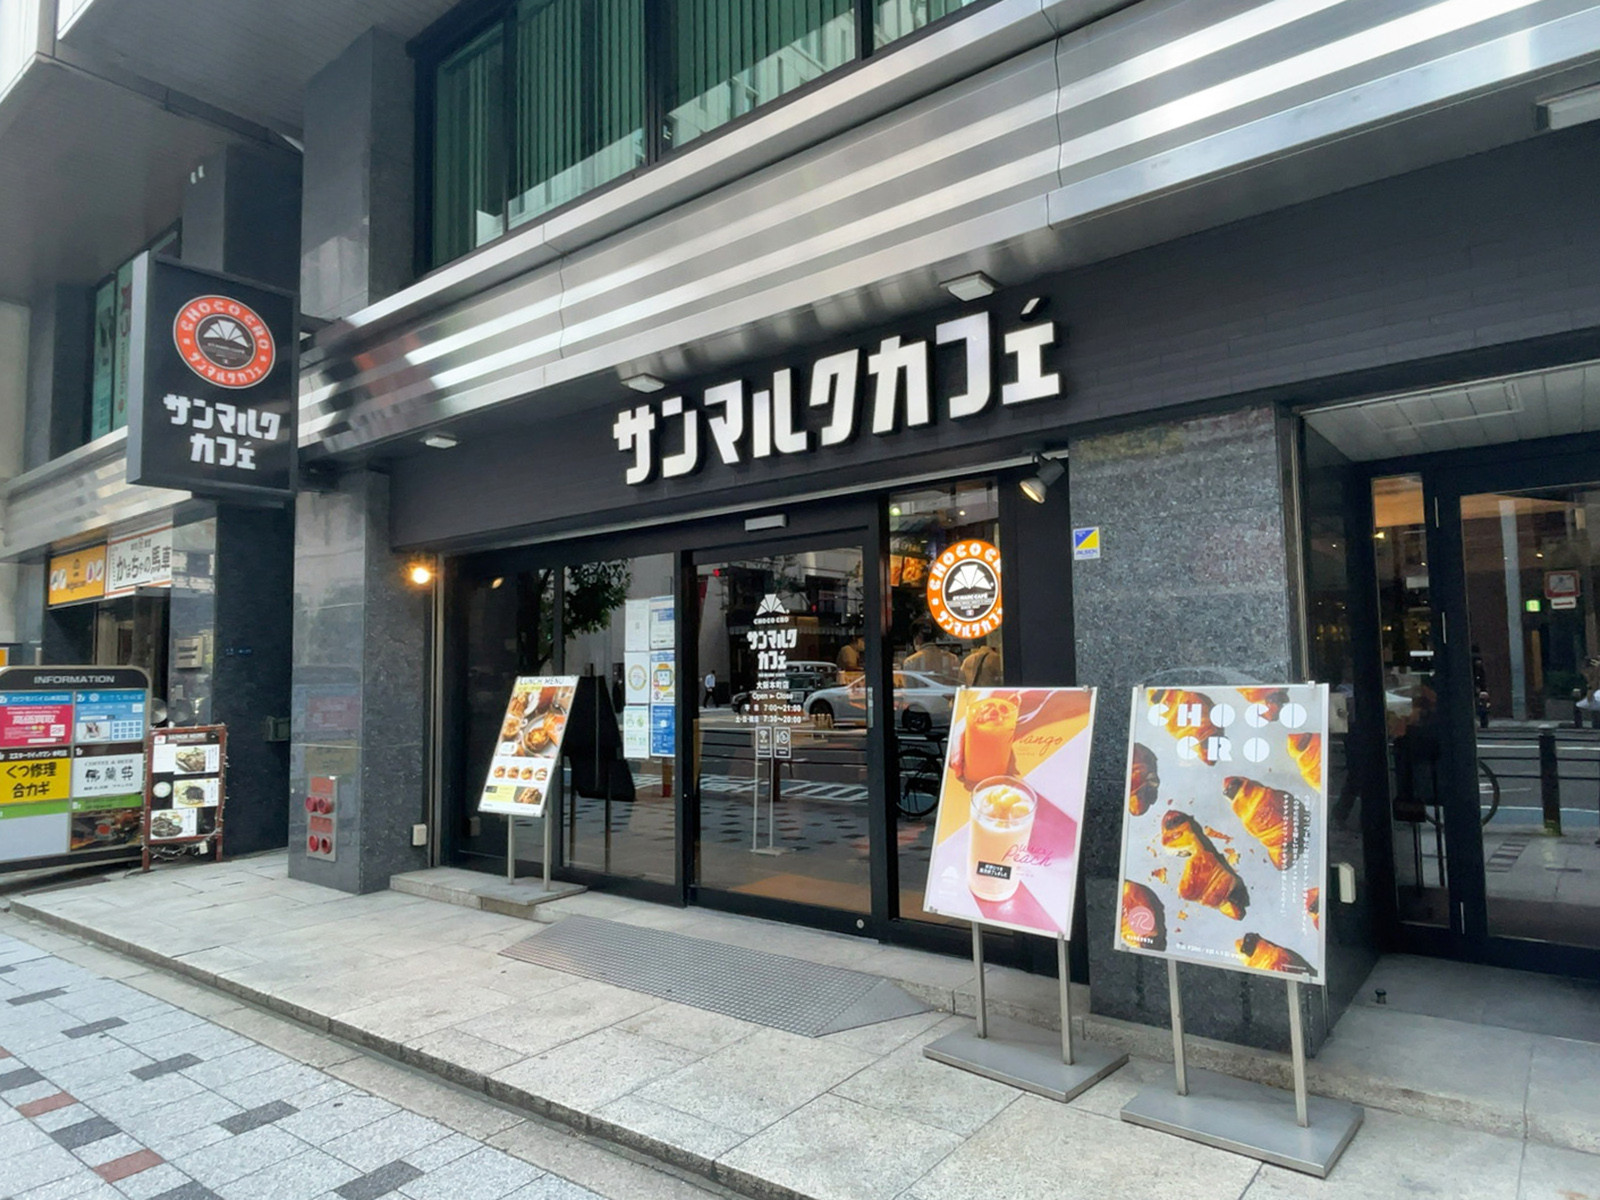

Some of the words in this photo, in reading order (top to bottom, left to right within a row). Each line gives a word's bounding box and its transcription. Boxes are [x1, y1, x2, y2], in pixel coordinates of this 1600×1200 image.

[613, 297, 1062, 485] サンマルクカフェ
[163, 393, 281, 441] サンマルク
[190, 433, 256, 470] カフェ
[929, 542, 982, 590] CHOCO
[753, 617, 775, 625] CHOCO
[747, 629, 797, 650] サンマルク
[758, 650, 787, 670] カフェ
[34, 674, 115, 685] INFORMATION
[752, 692, 768, 701] Open
[1147, 703, 1307, 729] CHOCO
[1176, 736, 1270, 763] CRO
[6, 762, 57, 778] くつ修理
[13, 781, 50, 798] 合カギ
[1001, 844, 1053, 867] Peach
